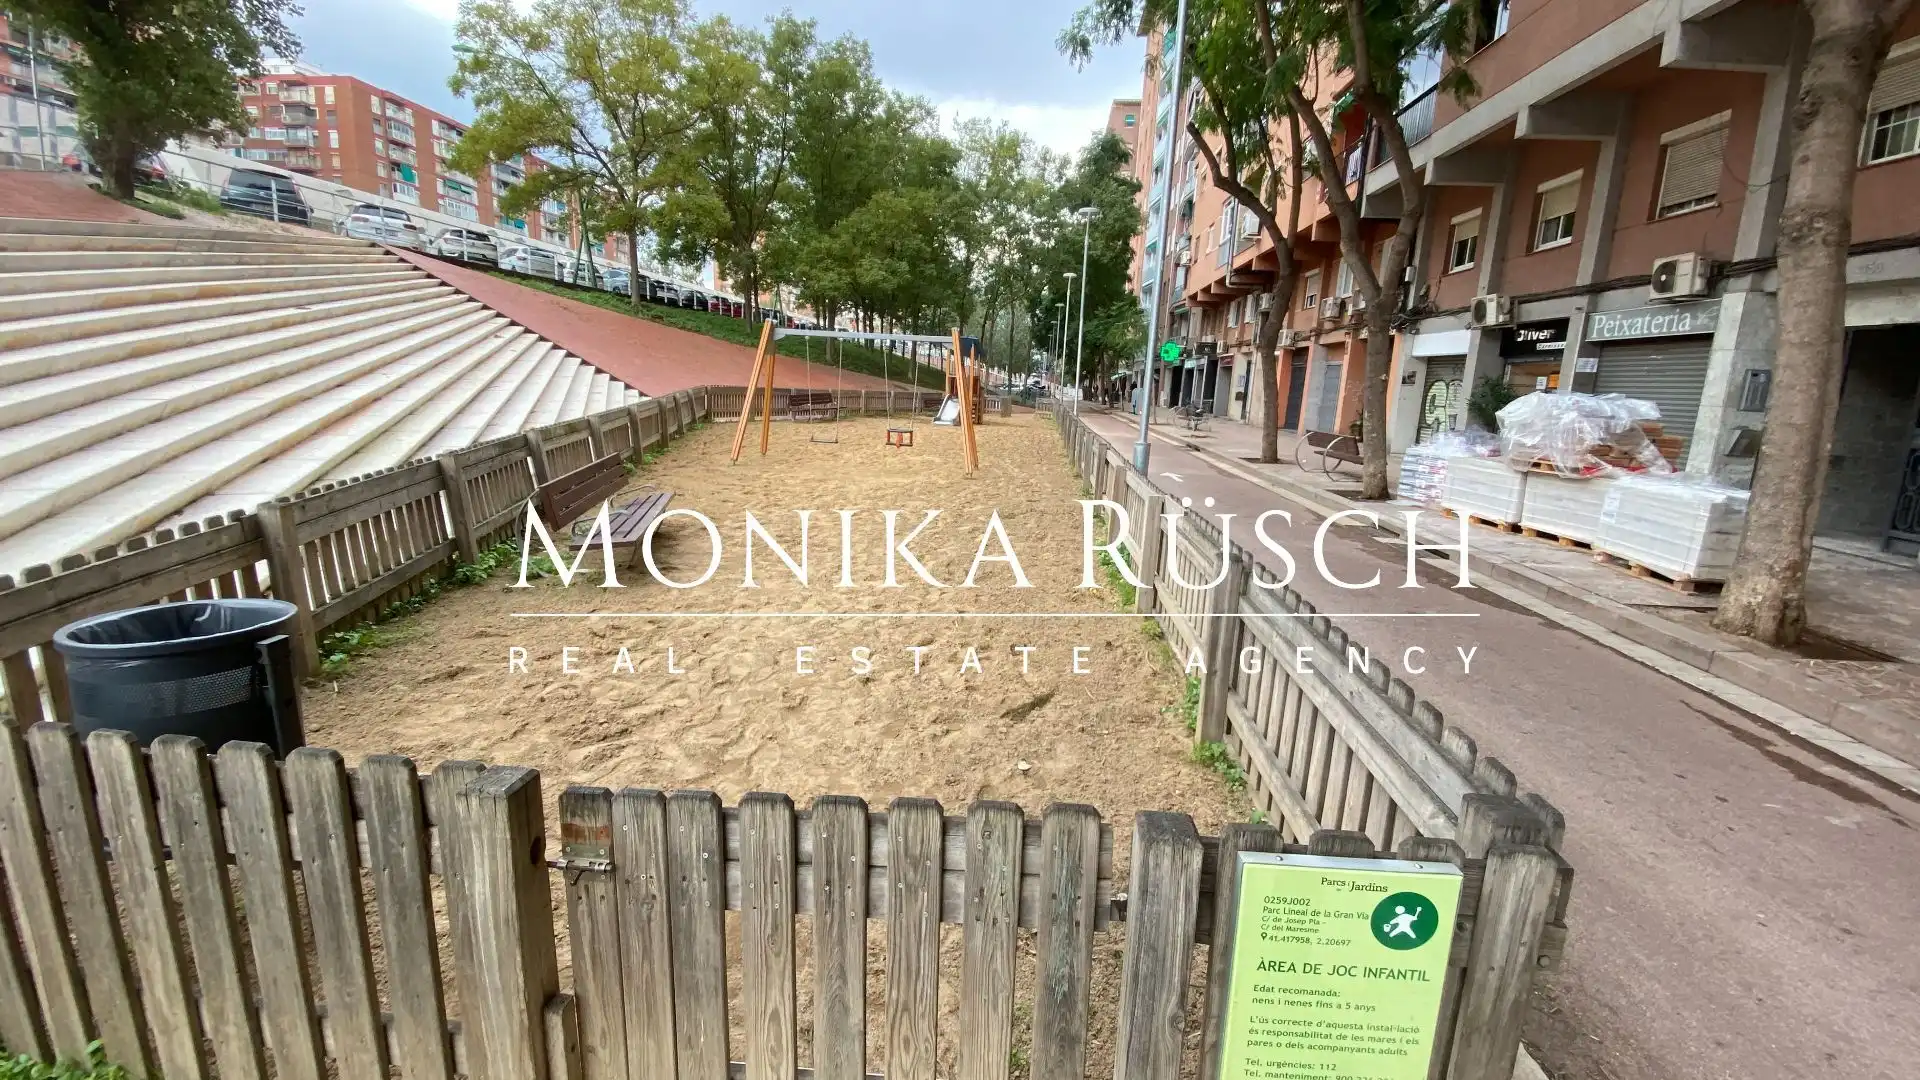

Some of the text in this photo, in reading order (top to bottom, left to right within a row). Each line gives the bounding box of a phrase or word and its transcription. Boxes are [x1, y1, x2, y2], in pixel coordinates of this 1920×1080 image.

[1591, 308, 1691, 338] Peixateria
[1321, 877, 1346, 887] Parcs
[1349, 881, 1388, 893] Jardins
[1264, 895, 1311, 907] 0259J002
[1262, 906, 1281, 915] Parc
[1283, 907, 1308, 917] Lineal
[1310, 909, 1321, 917] de
[1323, 909, 1331, 918] la
[1333, 910, 1354, 919] Gran
[1284, 917, 1306, 925] Josep
[1260, 923, 1270, 931] C/
[1285, 925, 1320, 934] Maresme
[1316, 937, 1351, 947] 2.20697
[1256, 957, 1431, 983] ÀREA DE JOC INFANTIL
[1253, 984, 1341, 998] Edat recomanada:
[1252, 996, 1275, 1006] nens
[1283, 999, 1313, 1008] nenes
[1315, 1000, 1333, 1010] fins
[1345, 1002, 1351, 1010] 5
[1353, 1004, 1376, 1013] anys
[1249, 1015, 1269, 1024] L'ús
[1271, 1018, 1313, 1027] correcte
[1316, 1019, 1364, 1031] d'aquesta
[1248, 1026, 1259, 1035] és
[1261, 1029, 1333, 1041] responsabilitat
[1335, 1032, 1348, 1041] de
[1351, 1033, 1365, 1042] les
[1367, 1036, 1397, 1044] mares
[1405, 1037, 1420, 1046] els
[1247, 1039, 1273, 1048] pares
[1285, 1041, 1305, 1050] dels
[1307, 1043, 1376, 1055] acompanyants
[1378, 1047, 1408, 1057] adults
[1245, 1057, 1262, 1067] Tel.
[1319, 1063, 1337, 1071] 112
[1244, 1068, 1261, 1078] Tel.
[1265, 1070, 1332, 1080] manteniment:
